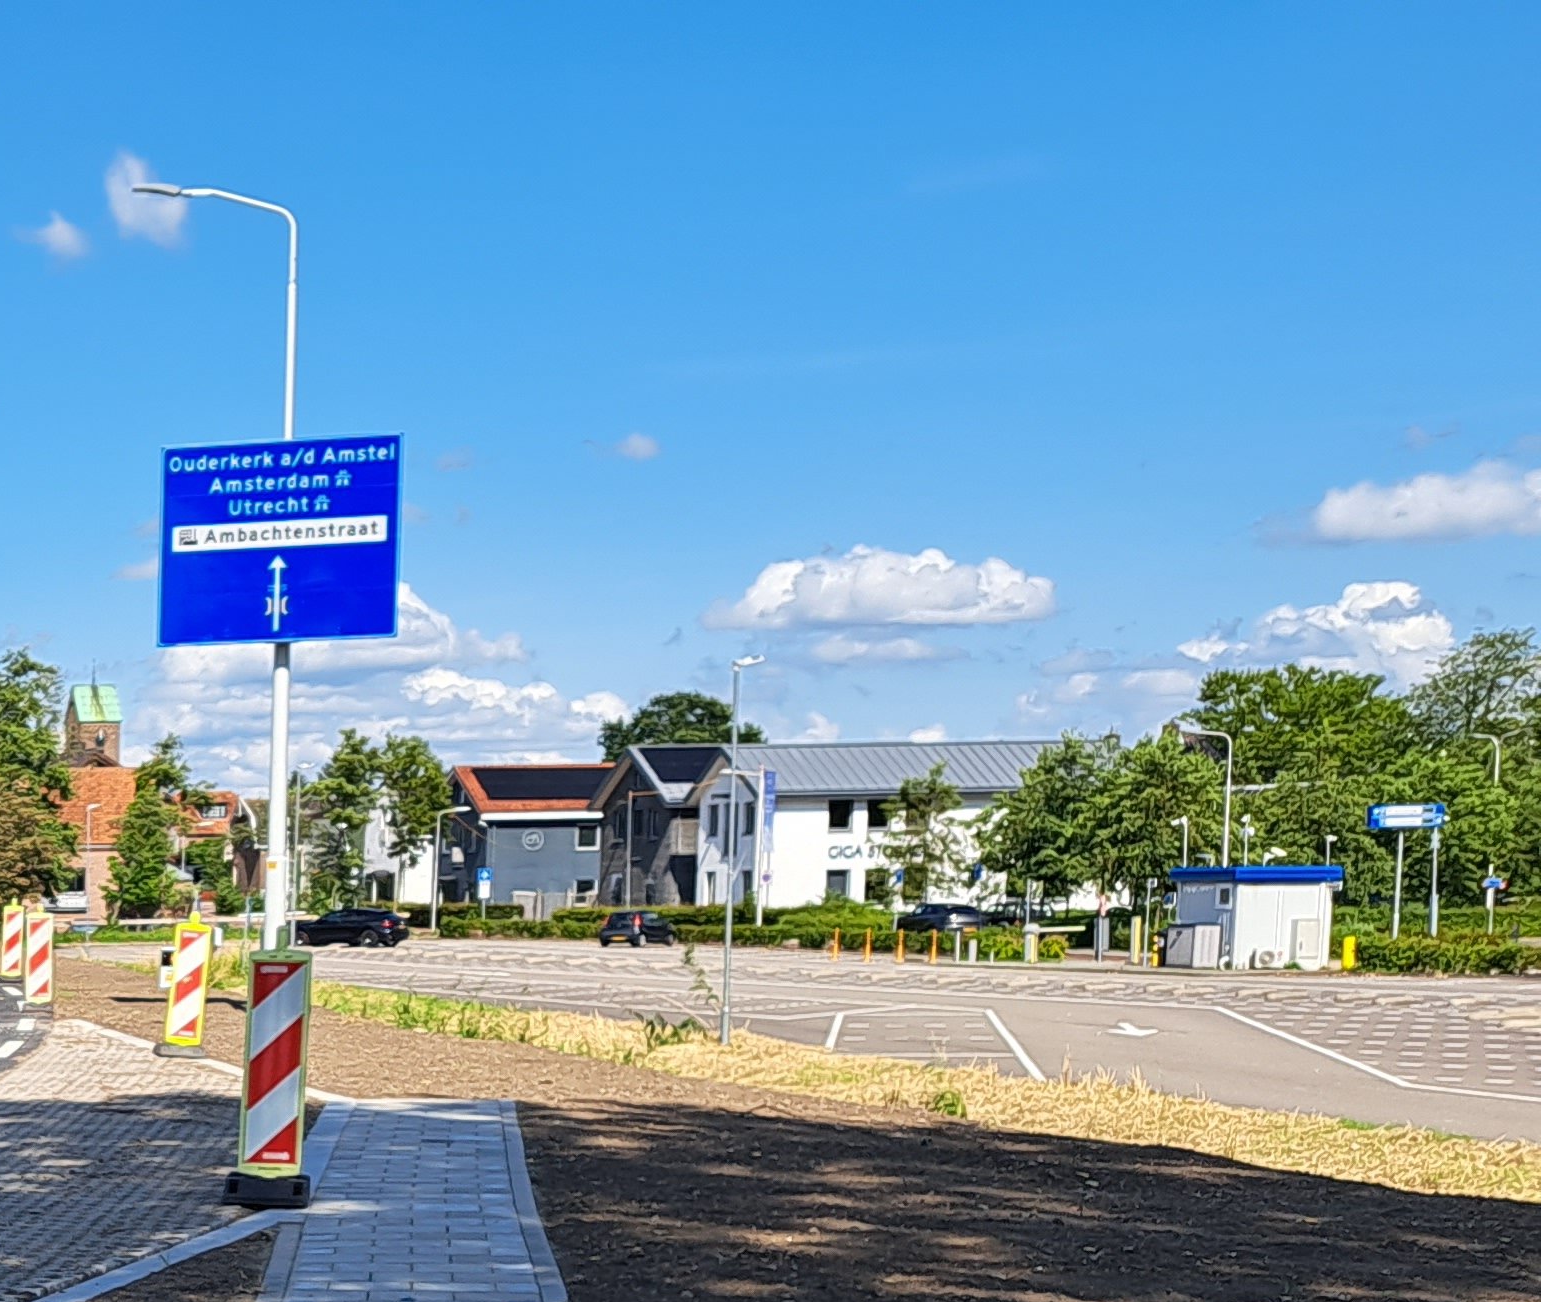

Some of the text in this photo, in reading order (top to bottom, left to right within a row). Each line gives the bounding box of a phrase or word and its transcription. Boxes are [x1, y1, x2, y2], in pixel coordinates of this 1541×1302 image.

[169, 443, 396, 473] Ouderkerk a/d Amstel
[209, 473, 329, 494] Amsterdam
[228, 496, 309, 515] Utrecht
[204, 521, 379, 544] Ambachtenstraat
